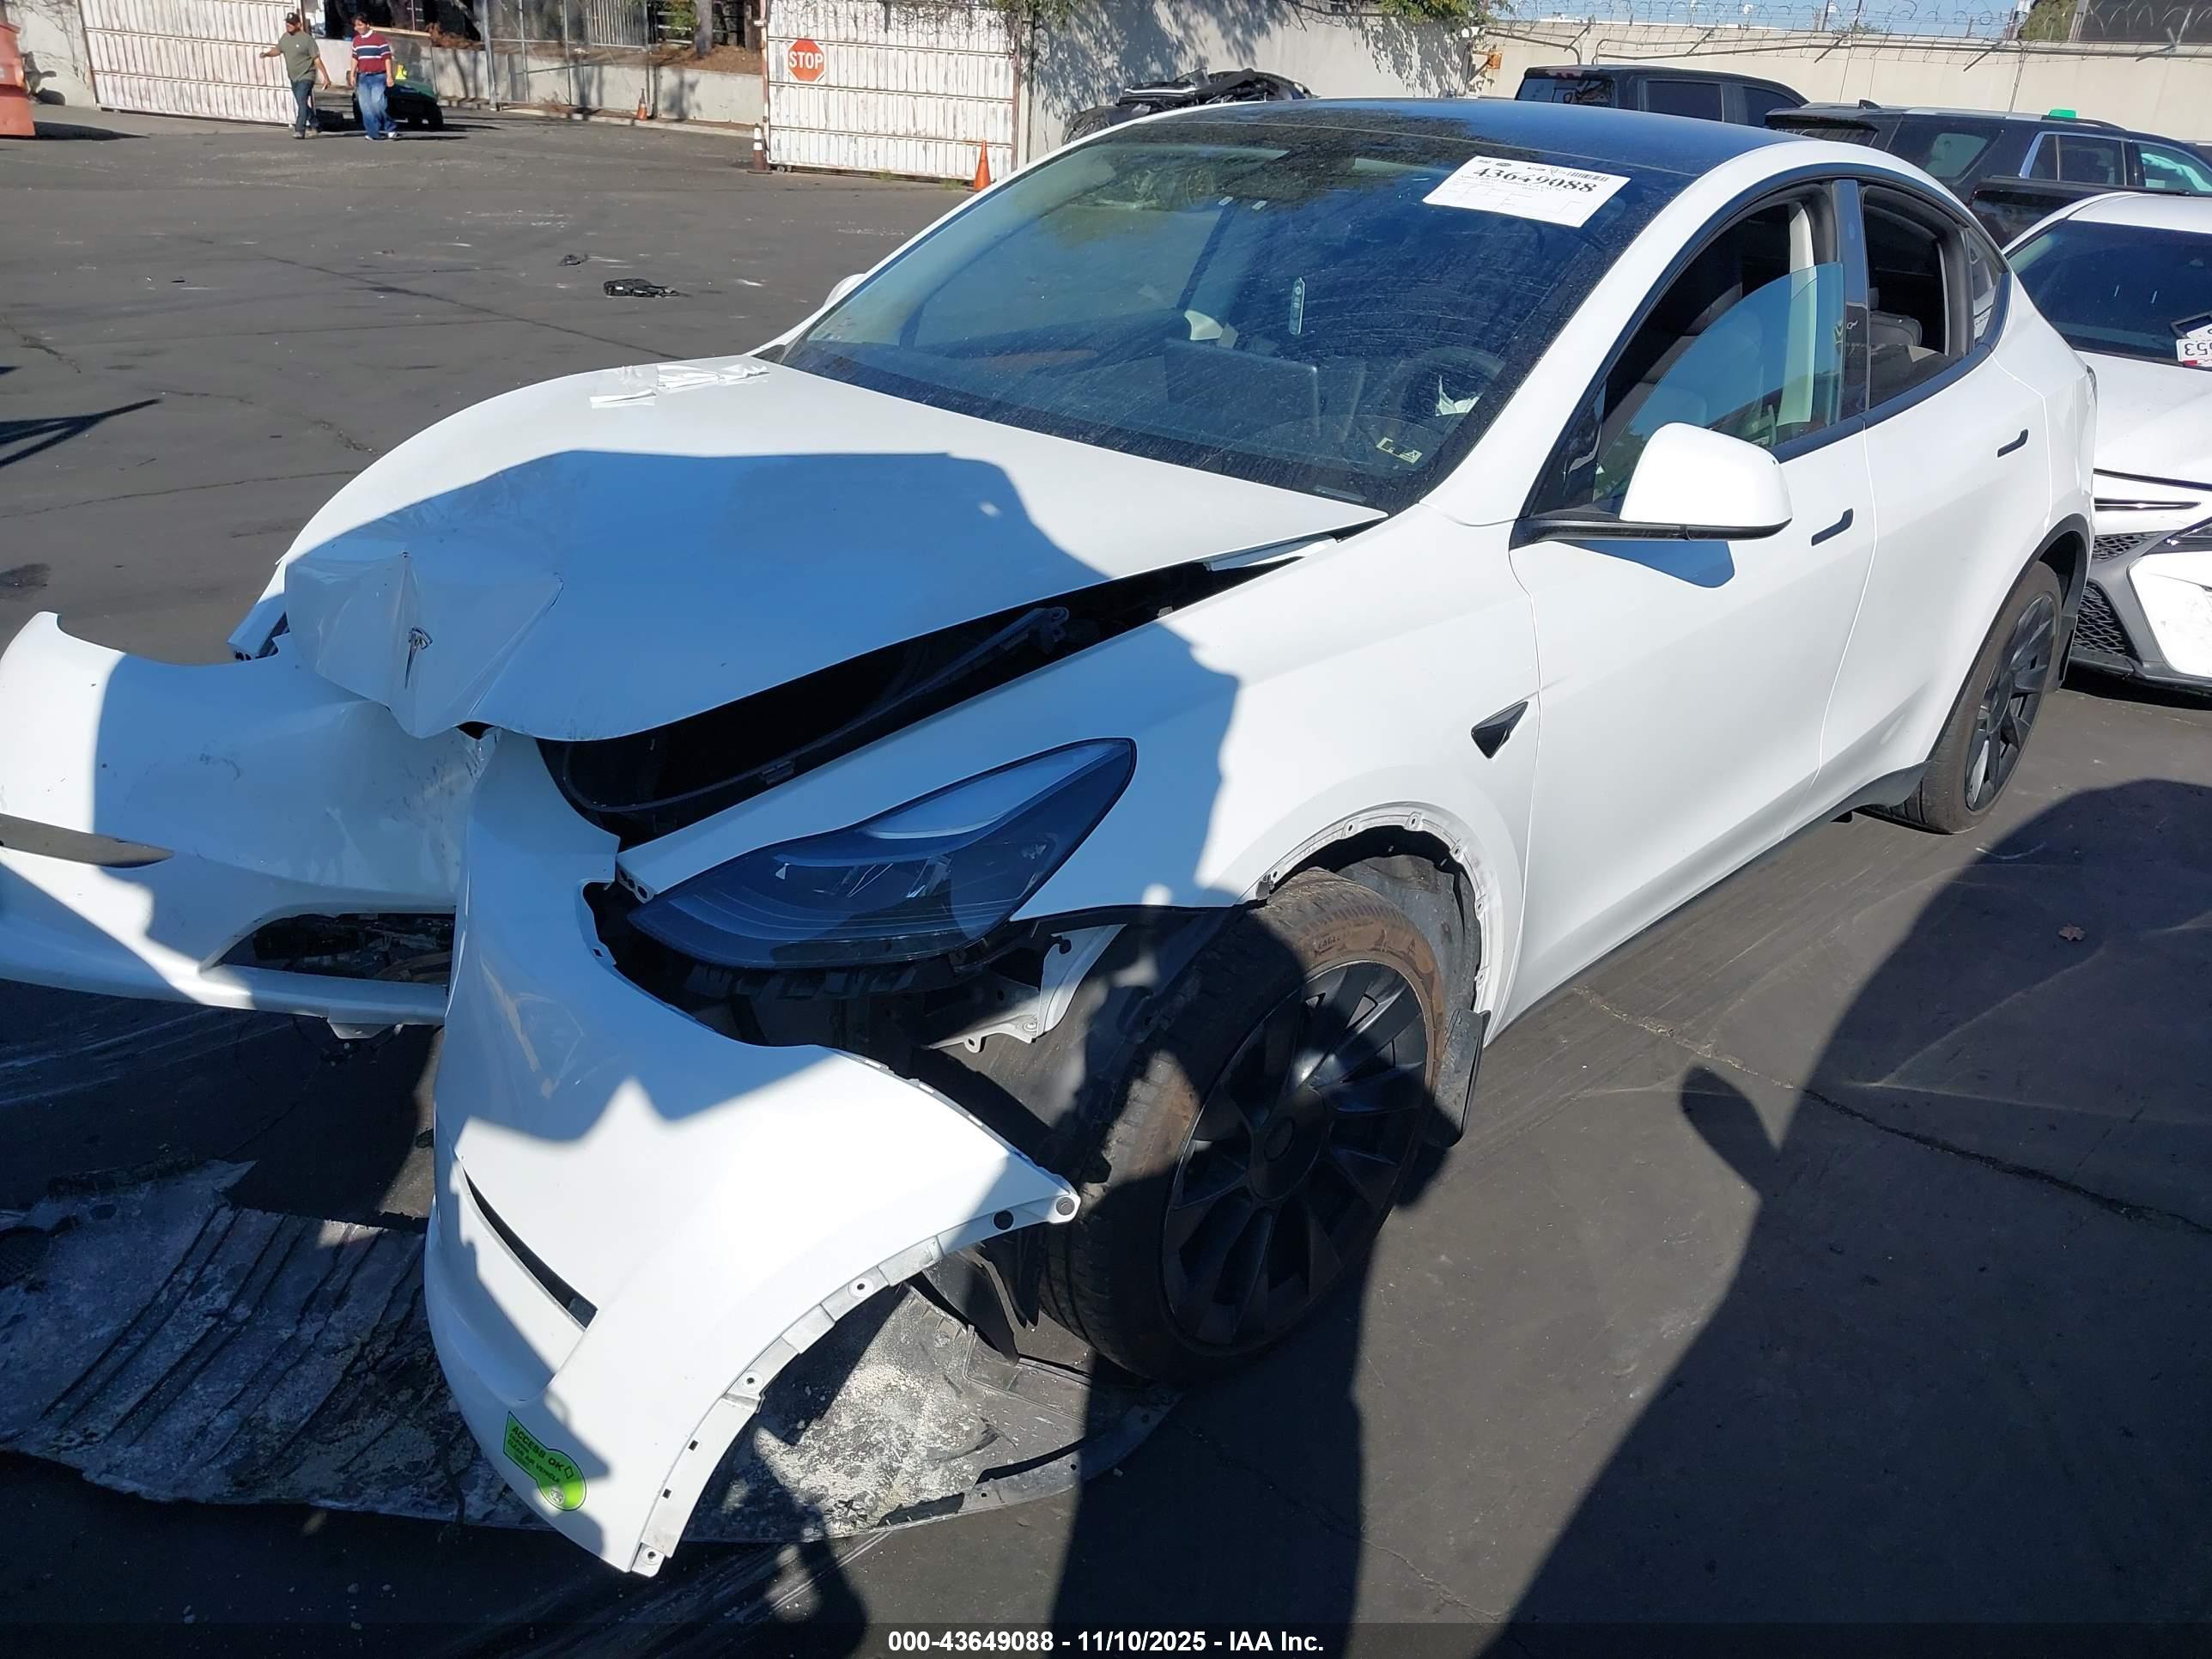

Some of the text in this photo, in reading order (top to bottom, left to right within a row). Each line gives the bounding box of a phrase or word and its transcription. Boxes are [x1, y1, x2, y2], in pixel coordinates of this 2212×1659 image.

[788, 51, 823, 69] STOP
[1474, 167, 1597, 192] 43649088
[2184, 342, 2212, 356] 53
[512, 1426, 546, 1458] ACCESS
[549, 1457, 564, 1471] OK
